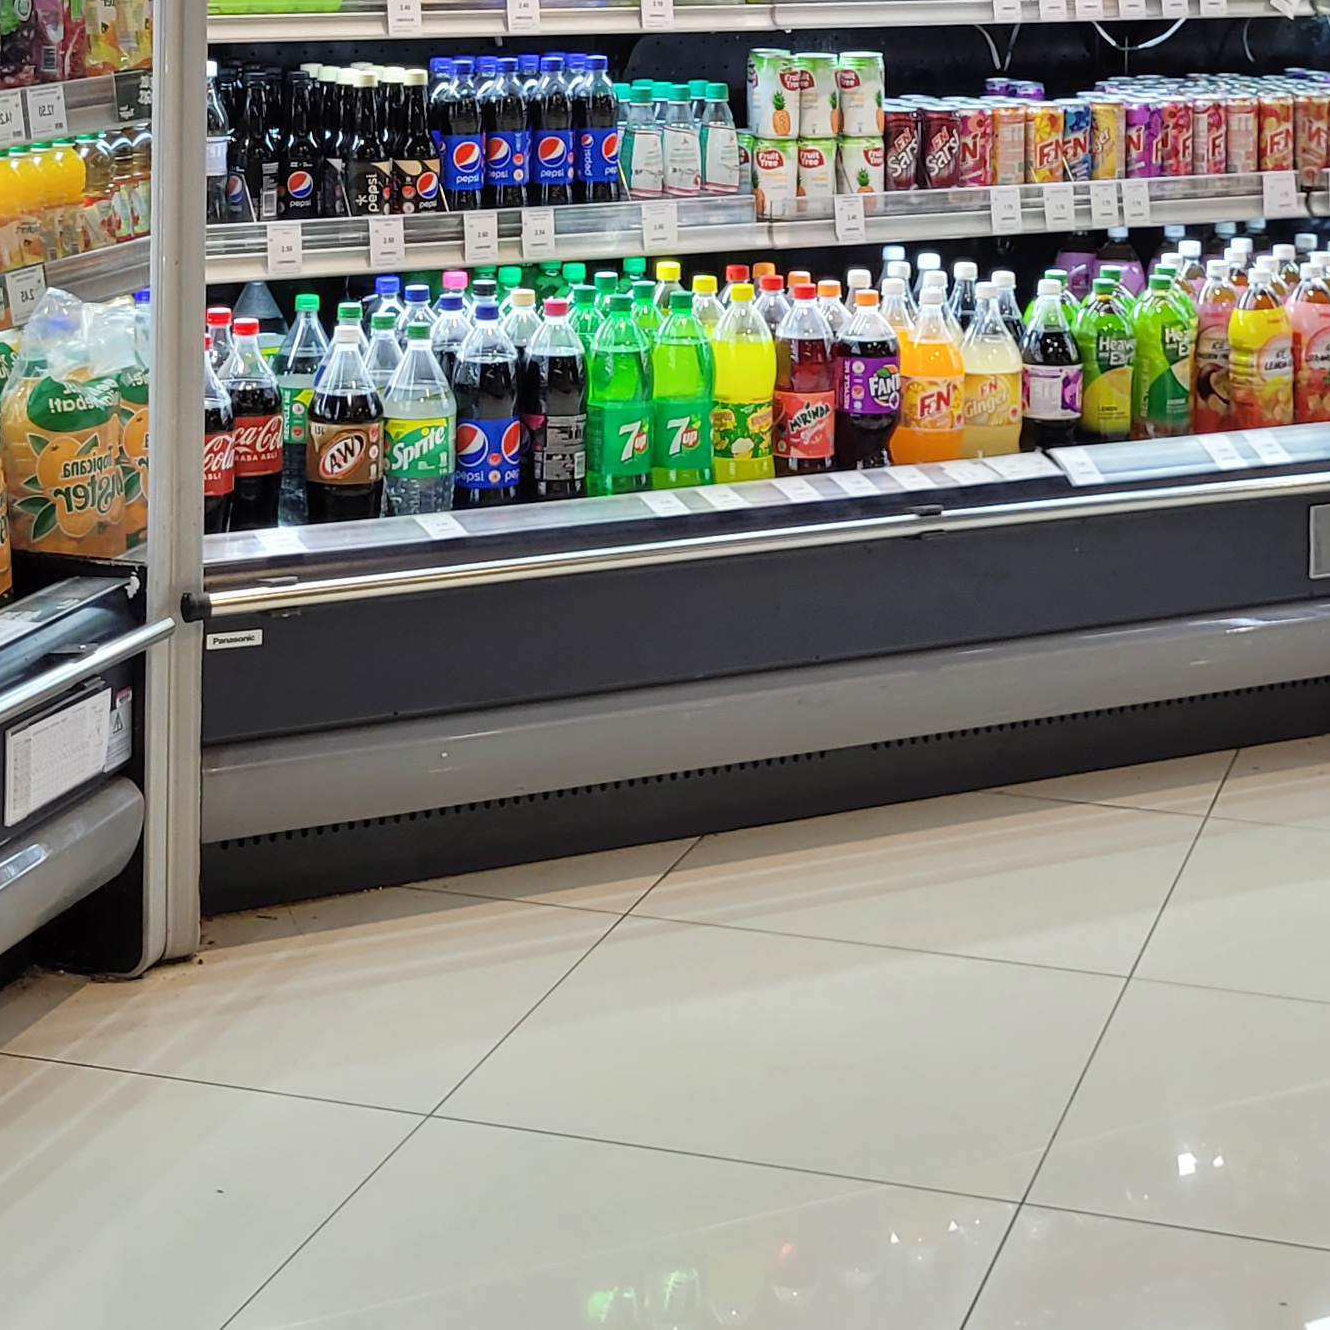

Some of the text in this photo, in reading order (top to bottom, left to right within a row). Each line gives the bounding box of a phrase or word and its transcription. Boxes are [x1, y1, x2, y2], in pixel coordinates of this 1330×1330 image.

[757, 151, 781, 161] Fruit
[759, 159, 779, 168] Tree
[456, 173, 480, 185] pepsi
[540, 168, 568, 180] pepsi
[367, 173, 381, 213] pepsi
[290, 197, 312, 209] pepsi
[419, 197, 438, 209] pepsi
[618, 420, 640, 463] 7
[666, 417, 690, 457] 7
[392, 429, 445, 470] Sprite
[456, 470, 484, 483] pepsi
[213, 634, 255, 644] Panasonic
